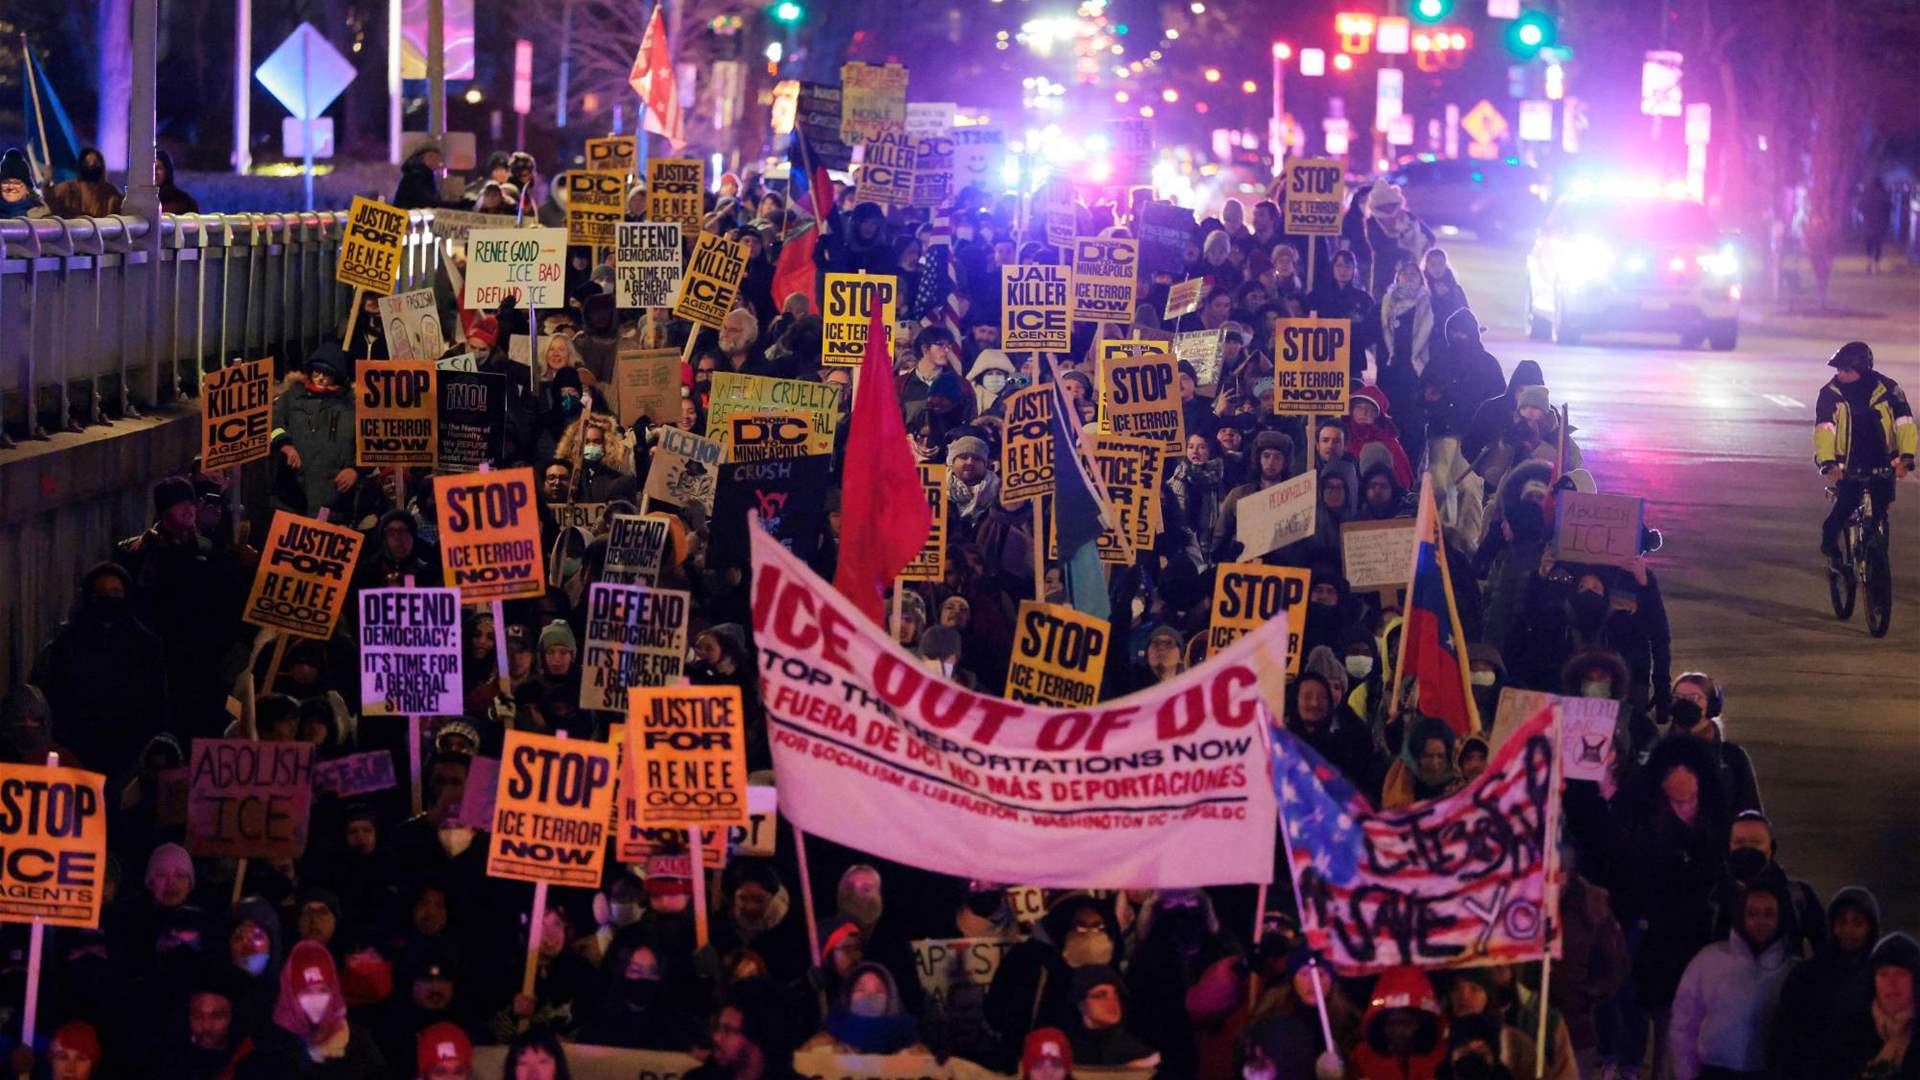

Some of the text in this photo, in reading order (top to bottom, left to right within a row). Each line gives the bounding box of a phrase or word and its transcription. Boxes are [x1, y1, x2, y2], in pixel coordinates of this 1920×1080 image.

[590, 141, 633, 160] DC
[865, 131, 916, 149] JAIL
[864, 144, 915, 169] KILLER
[653, 164, 700, 181] JUSTICE
[862, 166, 912, 188] ICE
[1292, 166, 1339, 195] STOP
[571, 175, 620, 194] DC
[652, 182, 697, 193] FOR
[571, 211, 620, 222] STOP
[653, 198, 697, 215] RENEE
[1305, 200, 1338, 214] TERROR
[354, 204, 404, 234] JUSTICE
[1291, 214, 1338, 224] NOW
[350, 225, 398, 248] FOR
[620, 225, 678, 248] DEFEND
[346, 242, 395, 271] RENEE
[475, 240, 539, 262] RENEE GOOD
[618, 249, 680, 262] DEMOCRACY:
[701, 236, 745, 262] JAIL
[1078, 242, 1134, 264] DC
[343, 260, 391, 282] GOOD
[506, 263, 560, 283] ICE BAD
[618, 266, 680, 281] IT'S TIME FOR
[693, 250, 742, 285] KILLER
[1007, 266, 1066, 282] JAIL
[1077, 263, 1133, 278] MINNEAPOLIS
[525, 286, 546, 304] ICE
[624, 280, 673, 294] A GENERAL
[685, 280, 734, 310] ICE
[830, 280, 893, 317] STOP
[1007, 282, 1066, 306] KILLER
[1075, 283, 1132, 300] ICE TERROR
[631, 292, 667, 307] STRIKE!
[683, 297, 727, 317] AGENTS
[1077, 299, 1129, 311] NOW
[1008, 310, 1066, 330] ICE
[825, 323, 892, 343] ICE TERR
[1008, 331, 1066, 340] AGENTS
[1283, 326, 1344, 362] STOP
[828, 342, 867, 354] NO
[209, 362, 268, 391] JAIL
[1112, 363, 1172, 404] STOP
[1279, 370, 1344, 388] ICE TERROR
[208, 380, 268, 419] KILLER
[364, 370, 430, 409] STOP
[714, 375, 839, 409] WHEN CRUELTY
[1282, 390, 1341, 400] NOW
[1009, 386, 1053, 423] JUSTI
[209, 410, 268, 446] ICE
[361, 418, 431, 438] ICE TERROR
[733, 417, 808, 446] DC
[752, 416, 788, 424] FROM
[1113, 410, 1178, 431] ICE TERROR
[365, 438, 430, 450] NOW
[1008, 422, 1053, 444] FO
[208, 434, 268, 458] AGENTS
[734, 445, 807, 463] MINNEAPOLIS
[1008, 439, 1053, 473] RENE
[734, 463, 792, 481] CRUSH
[1007, 466, 1053, 488] GOO
[447, 481, 527, 533] STOP
[278, 523, 357, 563] JUSTICE
[611, 519, 665, 549] DEFEND
[1563, 523, 1624, 556] ICE
[449, 539, 535, 568] ICE TERROR
[270, 550, 346, 581] FOR
[455, 564, 532, 585] NOW
[263, 573, 338, 611] RENEE
[1219, 573, 1303, 621] STOP
[255, 597, 331, 625] GOOD
[364, 593, 456, 626] DEFEND
[593, 587, 683, 629] DEFEND
[363, 626, 456, 648] DEMOCRACY:
[589, 620, 681, 650] DEMOCRACY:
[1021, 611, 1104, 673] STOP
[365, 653, 458, 675] IT'S TIME FOR
[587, 646, 680, 678] IT'S TIME FOR
[754, 564, 1258, 753] ICE OUT OF DC
[375, 672, 449, 694] A GENERAL
[594, 669, 604, 687] A
[1010, 662, 1034, 688] ICE
[1037, 669, 1096, 706] TERROR
[384, 692, 440, 713] STRIKE!
[644, 697, 735, 729] JUSTICE
[762, 648, 833, 686] TOP
[903, 719, 1164, 774] DEPORTATIONS
[1173, 737, 1252, 763] NOW
[643, 732, 732, 751] FOR
[774, 686, 858, 738] FUERA
[864, 720, 900, 752] DE
[949, 761, 981, 789] NO
[987, 775, 1042, 802] MÁS
[1052, 764, 1247, 802] DEPORTACIONES
[193, 744, 314, 788] ABOLISH
[508, 745, 609, 809] STOP
[647, 760, 732, 790] RENEE
[775, 730, 1168, 830] FOR SOCIALISM & LIBERATION WASHINGTON DC
[0, 779, 96, 838] STOP
[646, 790, 738, 806] GOOD
[204, 794, 293, 843] ICE
[498, 810, 602, 846] ICE TERROR
[500, 840, 594, 865] NOW
